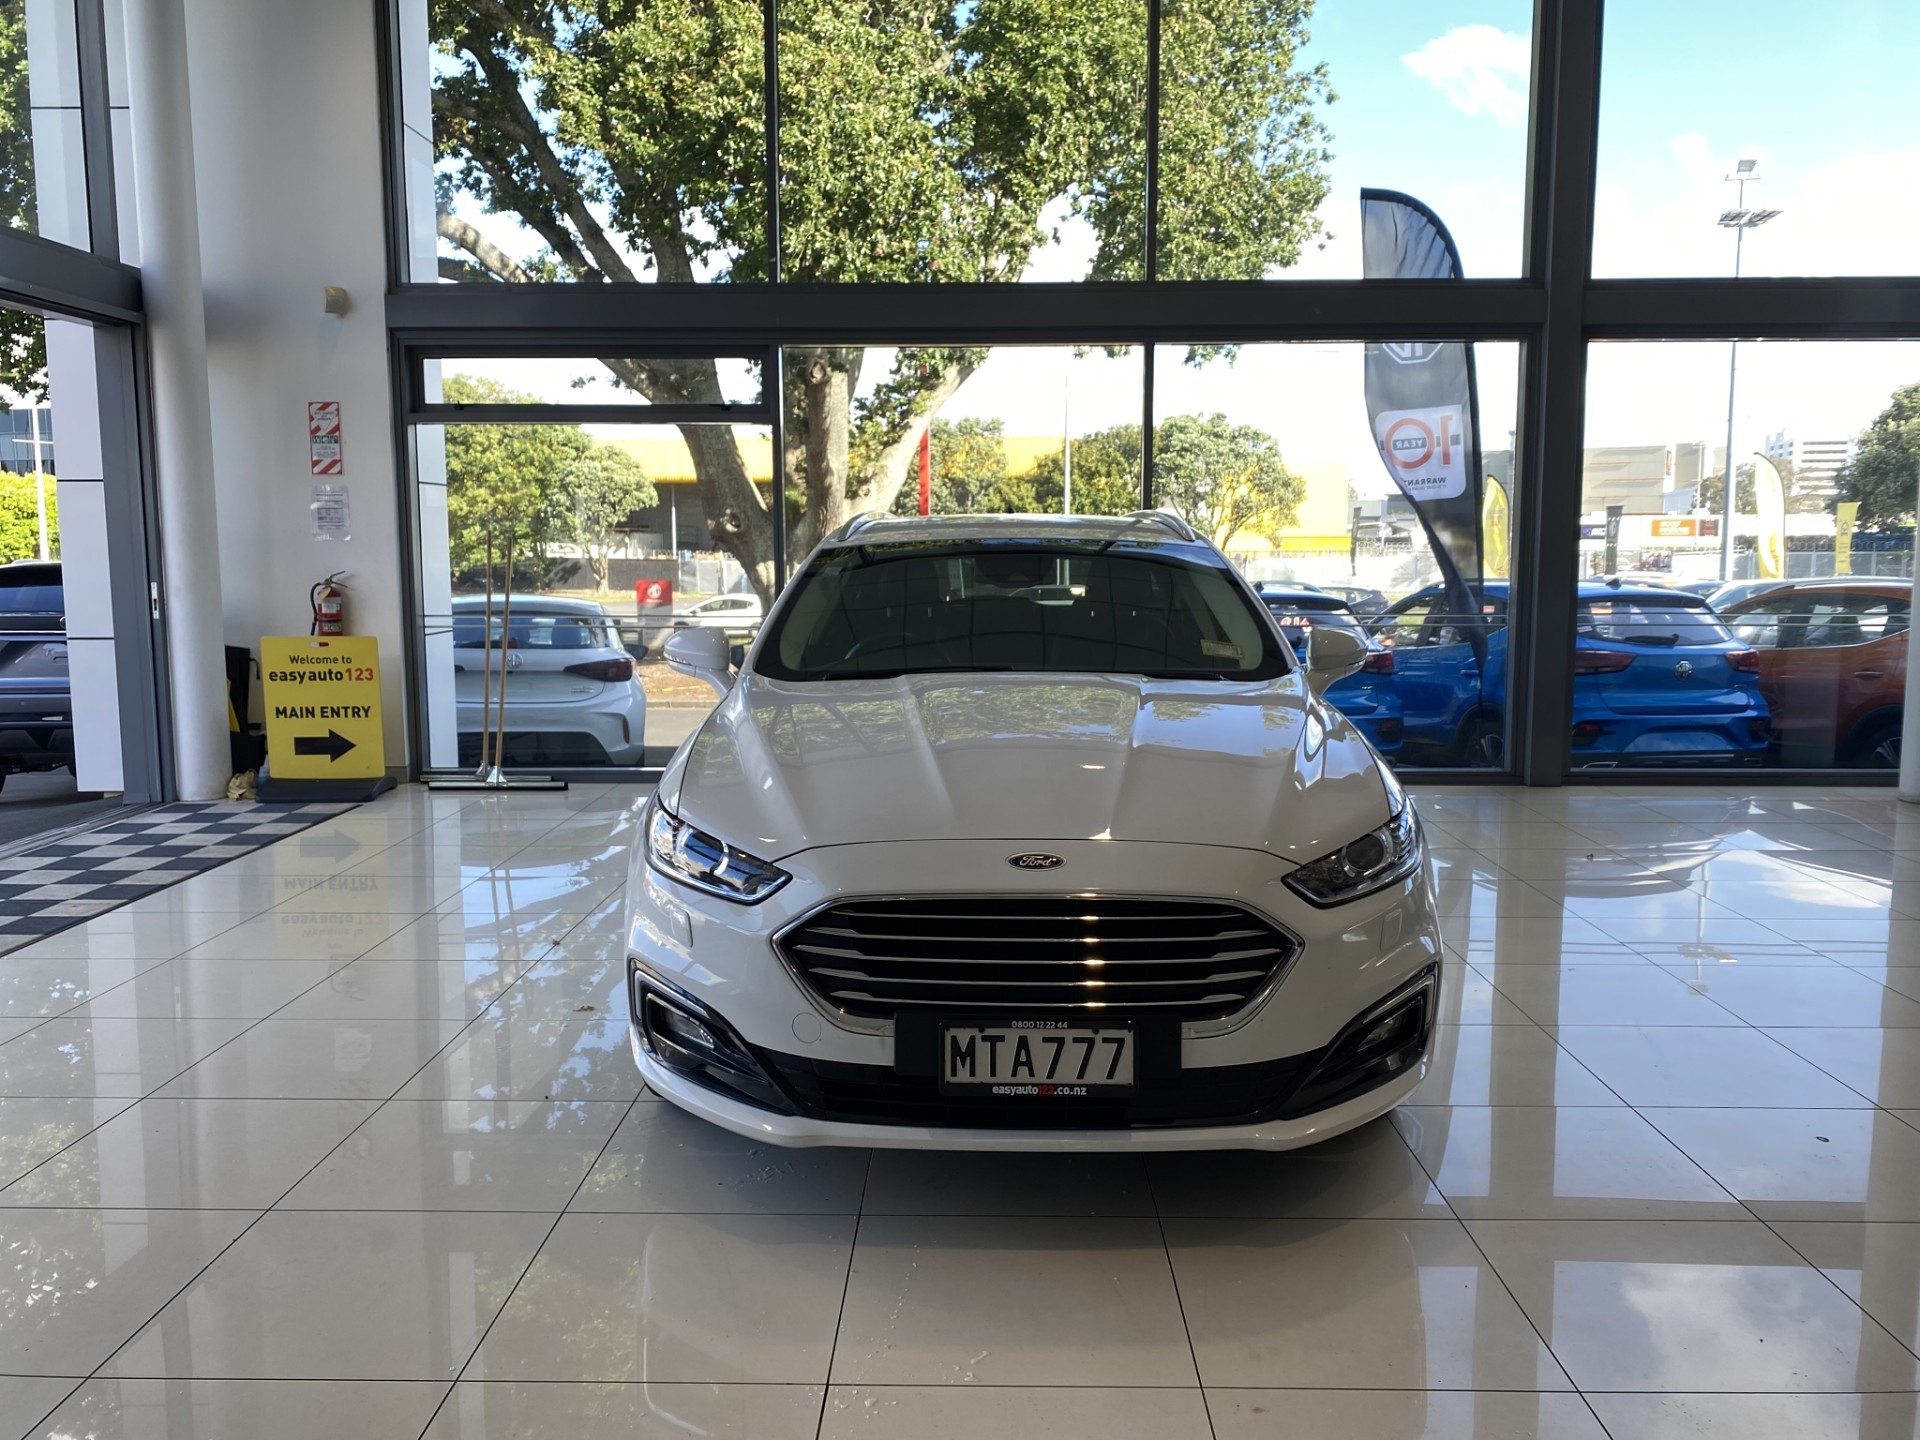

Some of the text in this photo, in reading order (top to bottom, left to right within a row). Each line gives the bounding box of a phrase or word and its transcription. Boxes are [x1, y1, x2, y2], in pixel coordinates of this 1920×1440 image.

[289, 655, 352, 664] Welcome to
[268, 668, 374, 684] easyauto123
[275, 706, 371, 718] MAIN ENTRY
[1011, 1020, 1068, 1029] 0800 12 22 44
[949, 1034, 1126, 1080] MTA777
[992, 1085, 1088, 1096] easyauto123.co.nz
